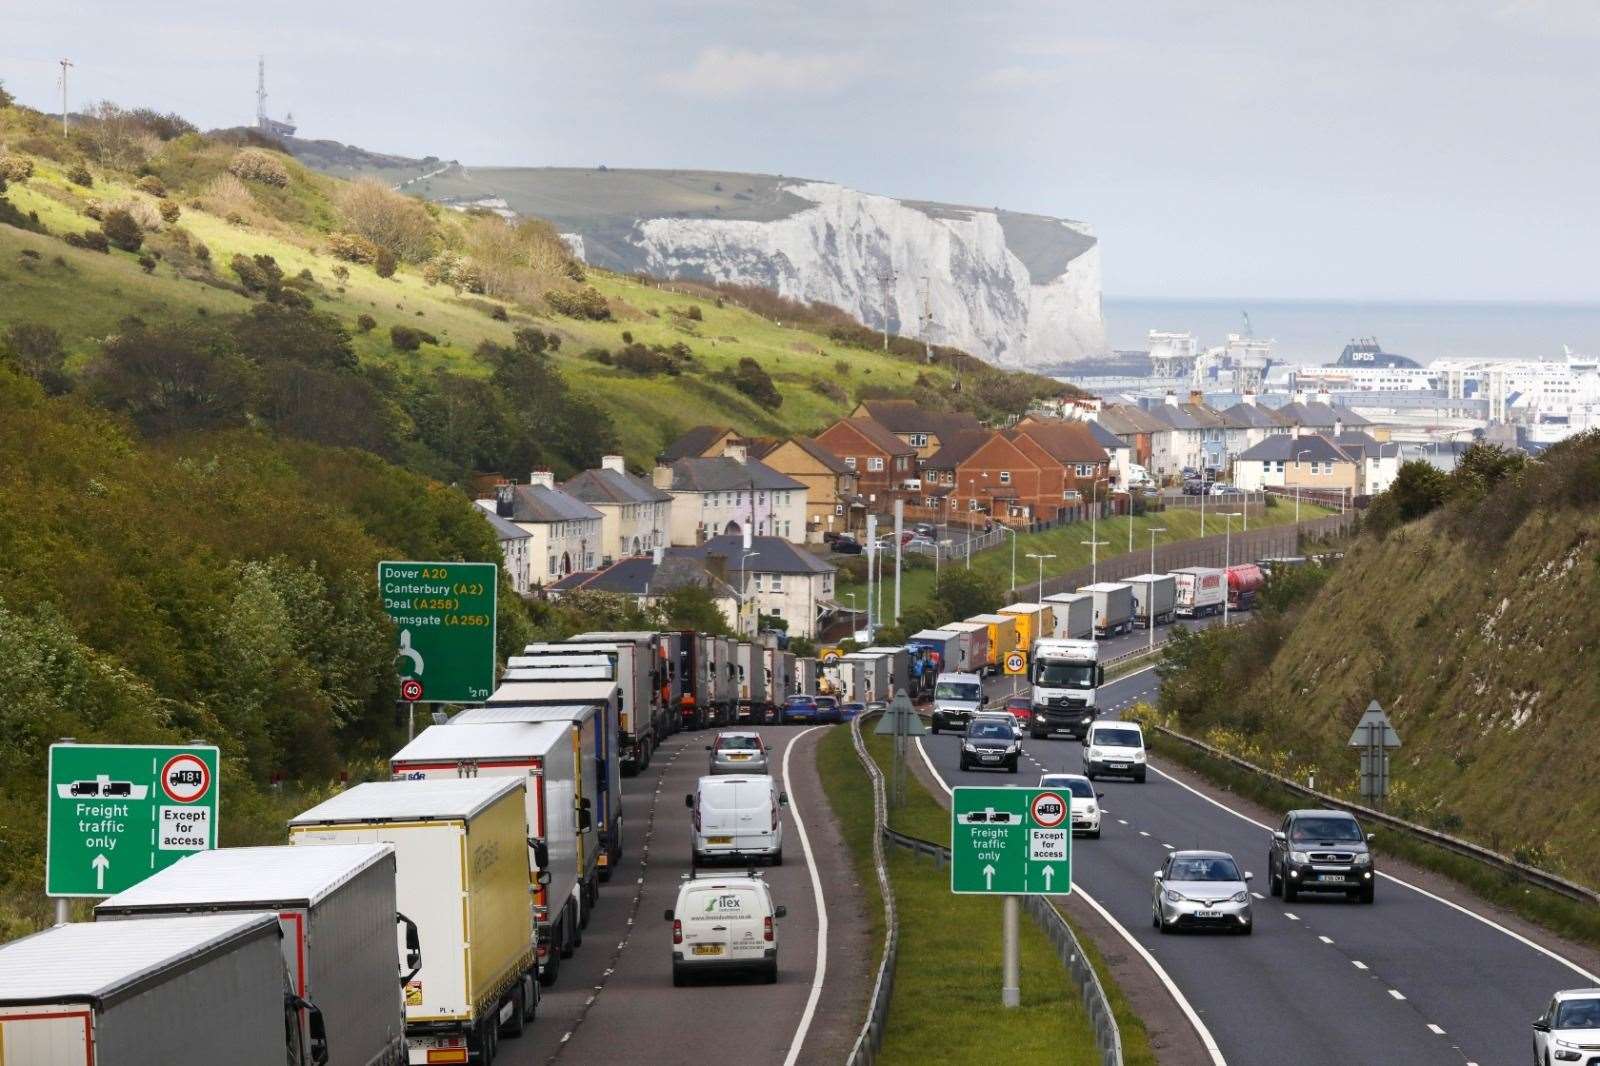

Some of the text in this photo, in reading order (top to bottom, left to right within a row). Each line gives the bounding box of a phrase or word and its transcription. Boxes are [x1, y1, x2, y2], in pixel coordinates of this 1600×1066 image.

[385, 568, 448, 579] Dover A20
[385, 582, 484, 596] Canterbury (A2)
[384, 597, 459, 610] Deal (A258)
[444, 613, 490, 626] (A256)
[1009, 658, 1022, 667] 40
[406, 685, 419, 695] 40
[76, 803, 129, 818] Freight
[164, 809, 206, 822] Except
[78, 819, 125, 833] traffic
[175, 823, 193, 833] for
[971, 828, 1009, 839] Freight
[1033, 831, 1064, 841] Except
[86, 835, 117, 850] only
[164, 836, 205, 846] access
[973, 839, 1006, 849] traffic
[1042, 840, 1055, 849] for
[978, 850, 1001, 861] only
[1033, 850, 1063, 858] access
